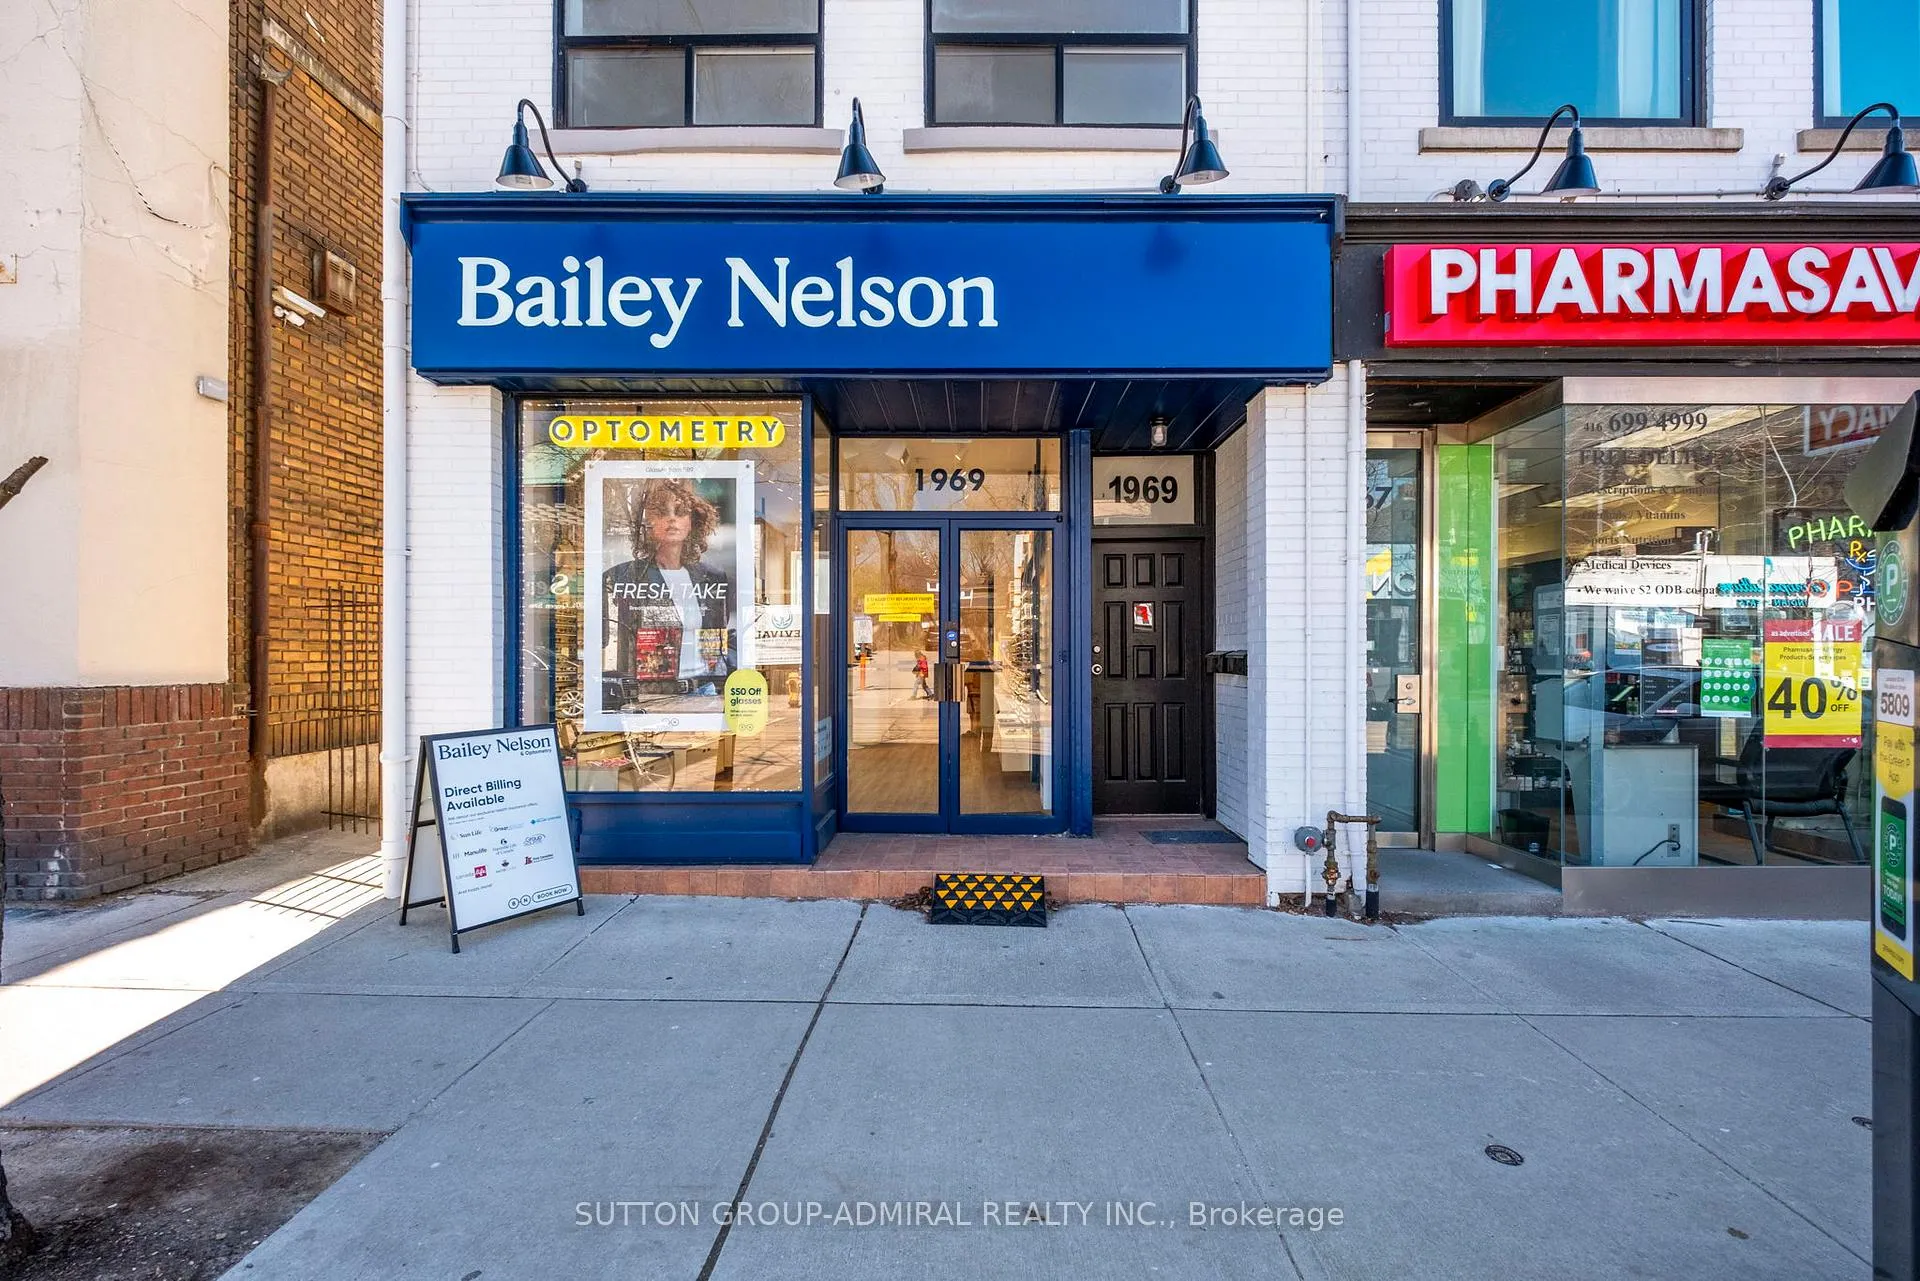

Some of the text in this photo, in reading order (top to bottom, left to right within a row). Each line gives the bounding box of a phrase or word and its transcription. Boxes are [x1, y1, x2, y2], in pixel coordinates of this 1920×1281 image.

[457, 255, 999, 349] Bailey Nelson
[551, 420, 778, 442] OPTOMETRY
[1583, 412, 1708, 432] 416 699 4999
[914, 467, 986, 492] 1969
[1108, 474, 1178, 504] 1969
[1583, 560, 1672, 571] Medical Devices
[612, 583, 728, 599] FRESH TAKE
[1584, 585, 1602, 595] We
[1604, 585, 1636, 595] waive
[1655, 585, 1682, 595] ODB
[1685, 585, 1720, 598] co-pa
[1779, 629, 1810, 637] advertised
[730, 688, 762, 696] $50 Off
[730, 697, 762, 706] glasses
[1830, 704, 1850, 712] OFF
[1880, 692, 1910, 717] 5809
[438, 736, 551, 760] Bailey Nelson
[444, 779, 522, 798] Direct Billing
[446, 794, 505, 812] Available
